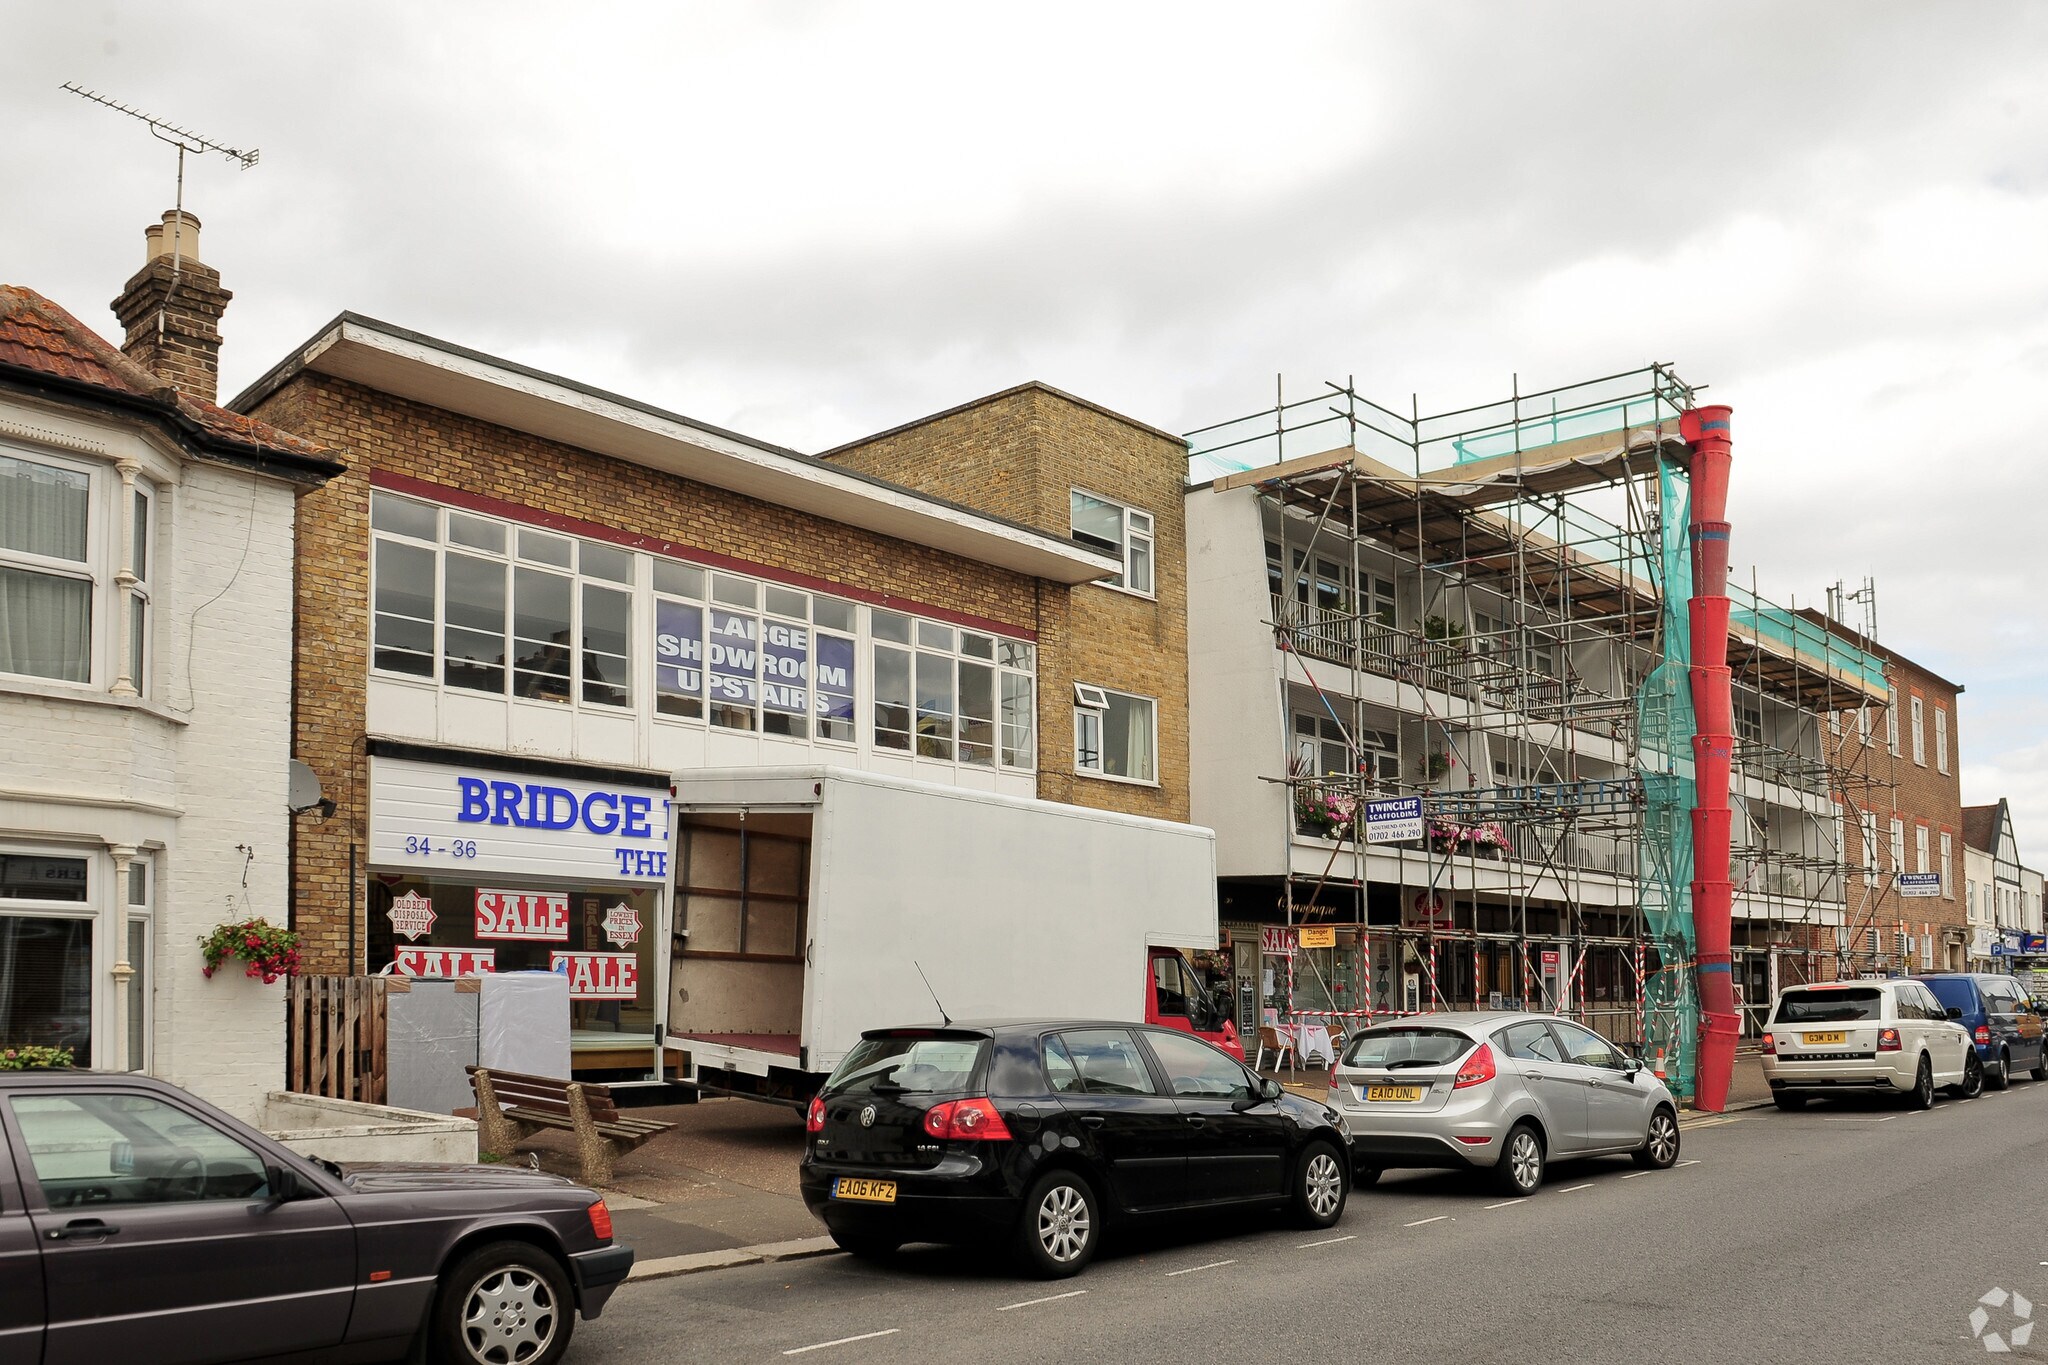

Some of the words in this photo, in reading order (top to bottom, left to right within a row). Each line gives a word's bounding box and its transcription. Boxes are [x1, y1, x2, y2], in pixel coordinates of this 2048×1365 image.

[709, 612, 807, 651] LARGE
[657, 634, 847, 688] SHOWROOM
[678, 668, 830, 713] UPSTAIRS
[457, 776, 651, 838] BRIDGE
[1368, 800, 1418, 813] TWINCLIFF
[1369, 810, 1418, 821] SCAFFOLDING
[1368, 832, 1389, 840] 01702
[1391, 830, 1405, 838] 466
[1407, 829, 1421, 837] 290
[405, 836, 431, 855] 34
[452, 839, 477, 859] 36
[396, 899, 412, 909] OLD
[412, 901, 427, 910] BED
[394, 910, 429, 920] DISPOSAL
[476, 893, 568, 934] SALE
[610, 911, 634, 919] LOWEST
[396, 920, 426, 931] SERVICE
[609, 917, 634, 925] PRICES
[609, 931, 634, 940] ESSEX
[1395, 1087, 1416, 1099] UNL
[838, 1179, 868, 1196] EA06
[869, 1181, 895, 1198] KFZ
